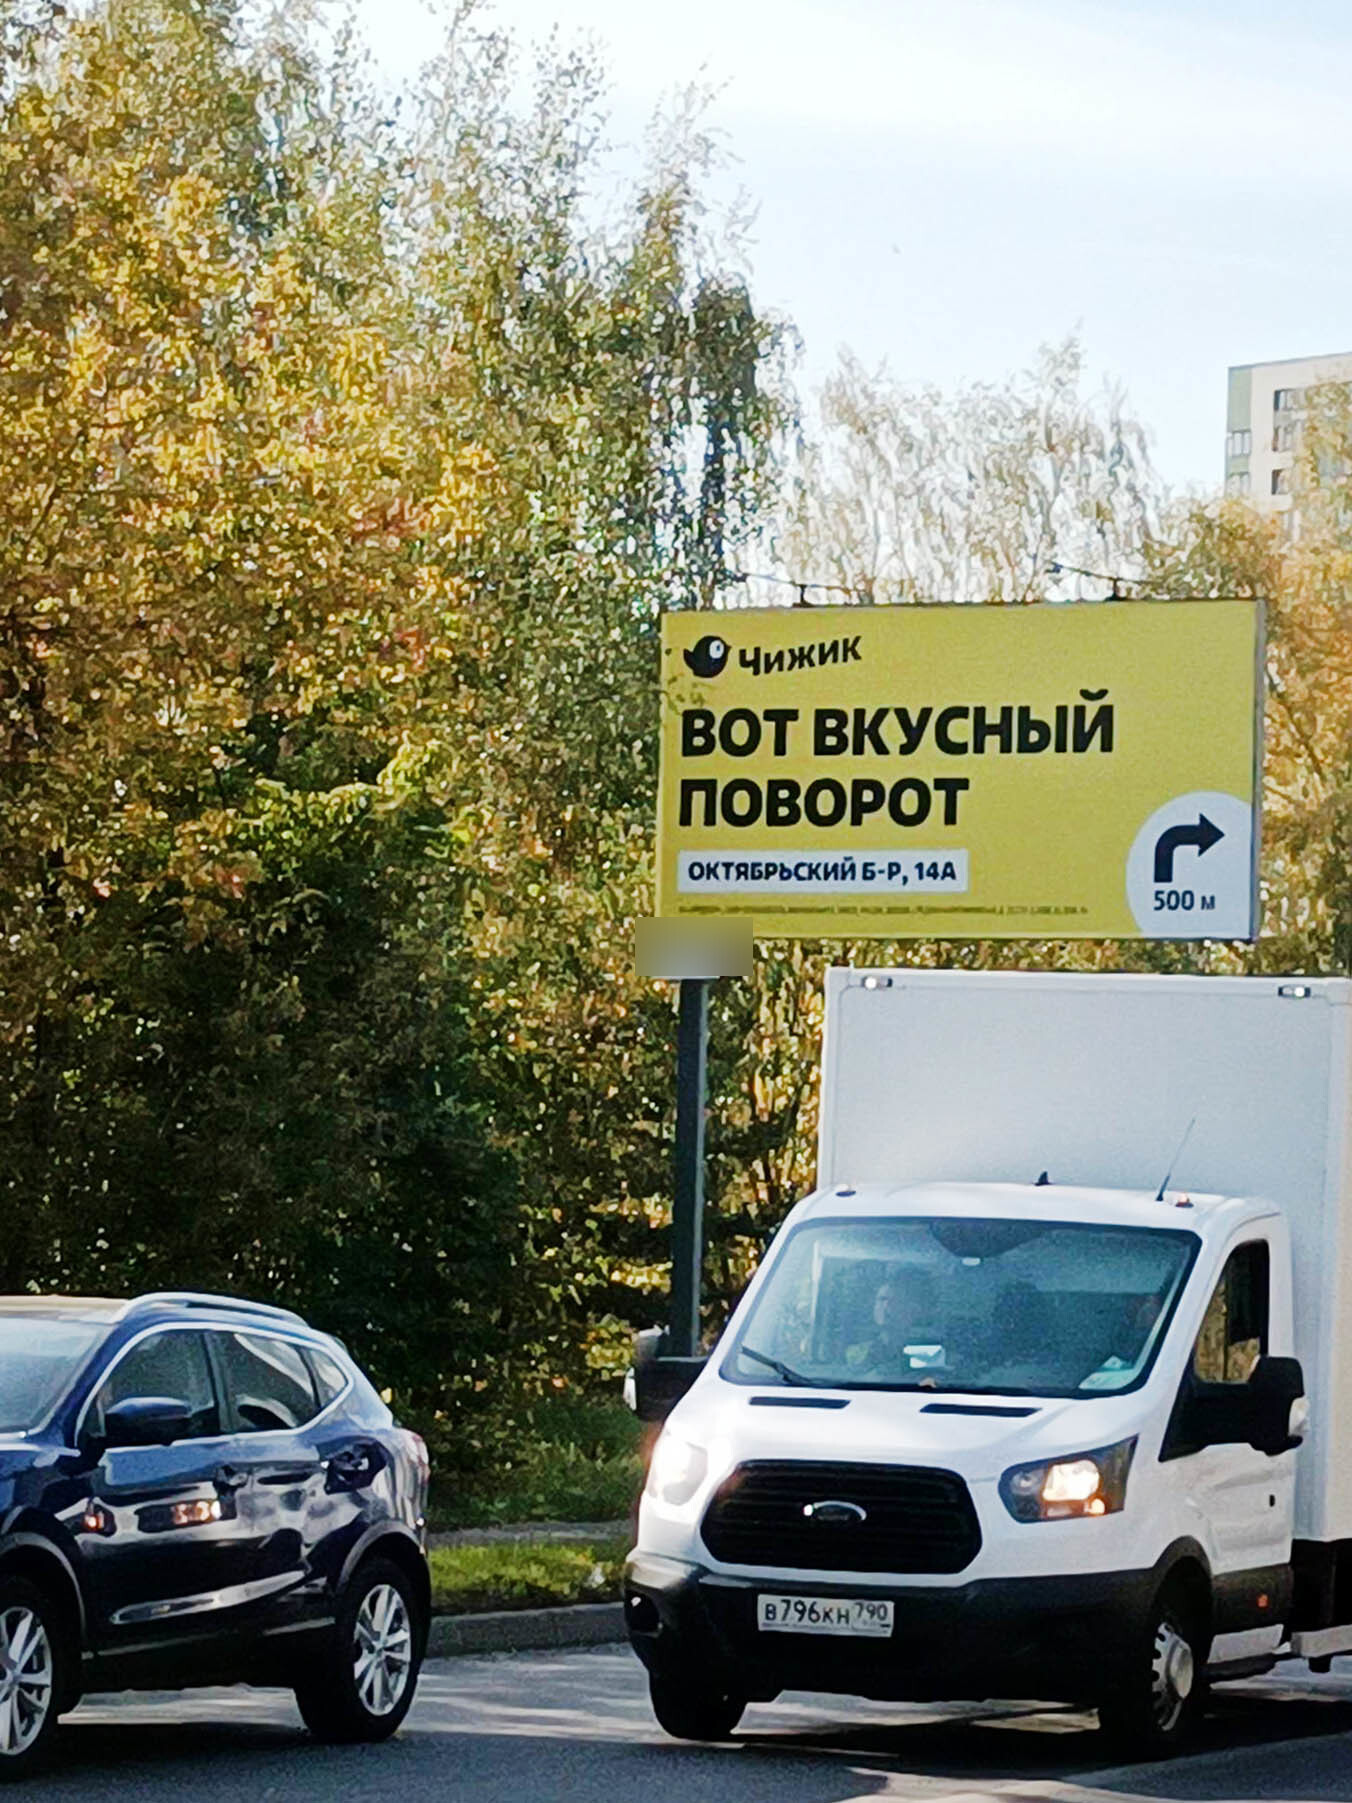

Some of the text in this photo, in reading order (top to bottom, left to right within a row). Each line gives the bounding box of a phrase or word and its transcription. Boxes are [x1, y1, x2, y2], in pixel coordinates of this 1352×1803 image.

[738, 636, 862, 676] Чижик
[681, 688, 1114, 757] ВОТ ВКУСНЫЙ
[679, 778, 970, 827] ПОВОРОТ
[687, 856, 856, 882] ОКТЯБРЬСКИЙ
[914, 861, 957, 881] 14А
[1153, 890, 1195, 911] 500
